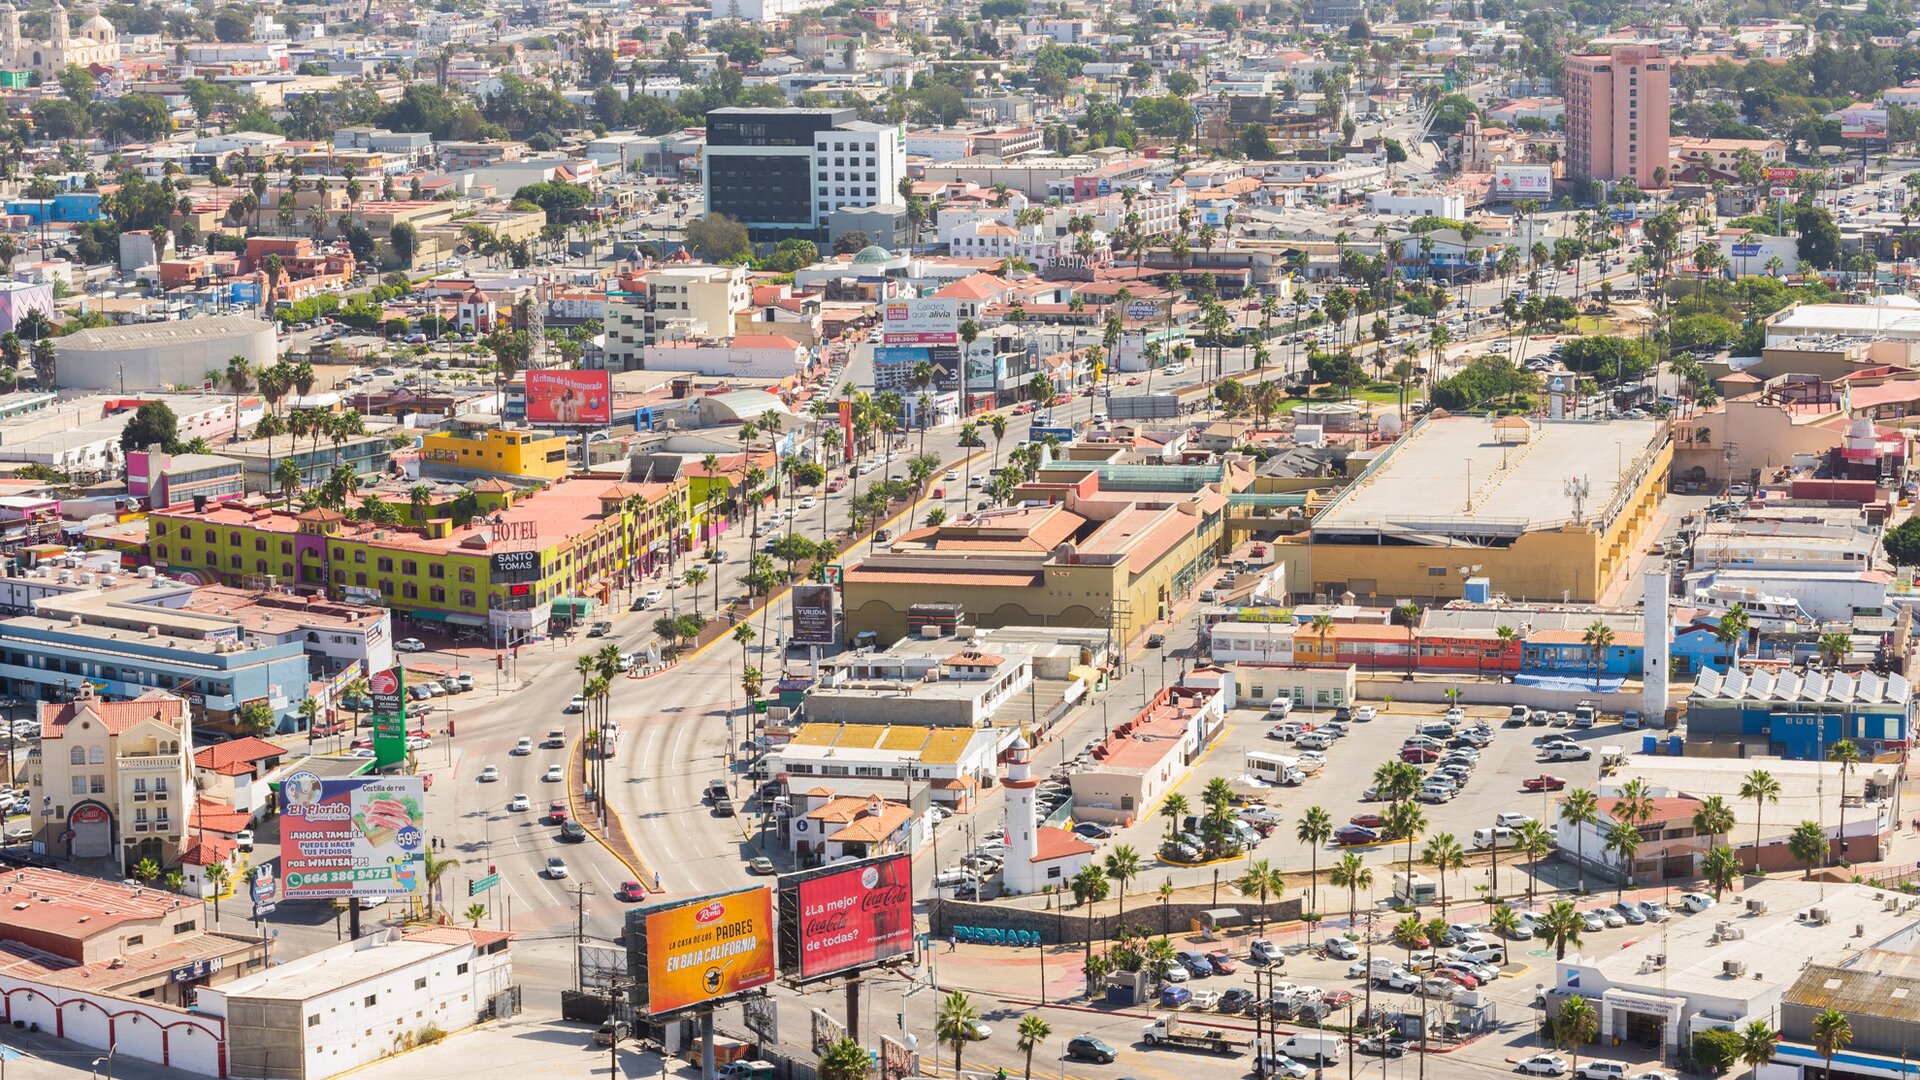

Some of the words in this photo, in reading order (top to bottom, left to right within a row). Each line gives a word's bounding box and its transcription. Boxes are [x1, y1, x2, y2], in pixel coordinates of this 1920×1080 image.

[917, 302, 945, 311] Calidez
[929, 310, 951, 318] alivia
[949, 368, 958, 380] 3
[532, 373, 539, 383] Al
[540, 374, 555, 382] ritmo
[556, 375, 564, 385] de
[565, 377, 571, 386] la
[571, 381, 603, 391] temporada
[492, 521, 537, 541] HOTEL
[498, 552, 533, 562] SANTO
[499, 562, 532, 570] TOMAS
[363, 784, 386, 793] Costilla
[288, 804, 303, 816] El
[306, 803, 350, 815] Florido
[290, 830, 324, 839] ¡AHORA
[326, 829, 365, 839] TAMBIÉN
[300, 841, 329, 849] PUEDES
[287, 859, 306, 868] POR
[307, 857, 370, 867] WHATSAPP!
[303, 873, 328, 883] 664
[330, 871, 355, 882] 386
[357, 868, 389, 880] 9475
[805, 903, 824, 917] ¿La
[827, 895, 858, 912] mejor
[699, 908, 721, 922] Roma
[669, 941, 676, 950] LA
[678, 938, 692, 948] CASA
[693, 935, 701, 944] DE
[702, 932, 712, 942] LOS
[716, 919, 753, 941] PADRES
[806, 941, 820, 952] de
[822, 929, 859, 947] todas?
[867, 935, 887, 943] Primero
[953, 925, 1042, 947] ENSENADA
[667, 955, 679, 972] EN
[680, 950, 703, 969] BAJA
[704, 935, 757, 961] CALIFORNIA
